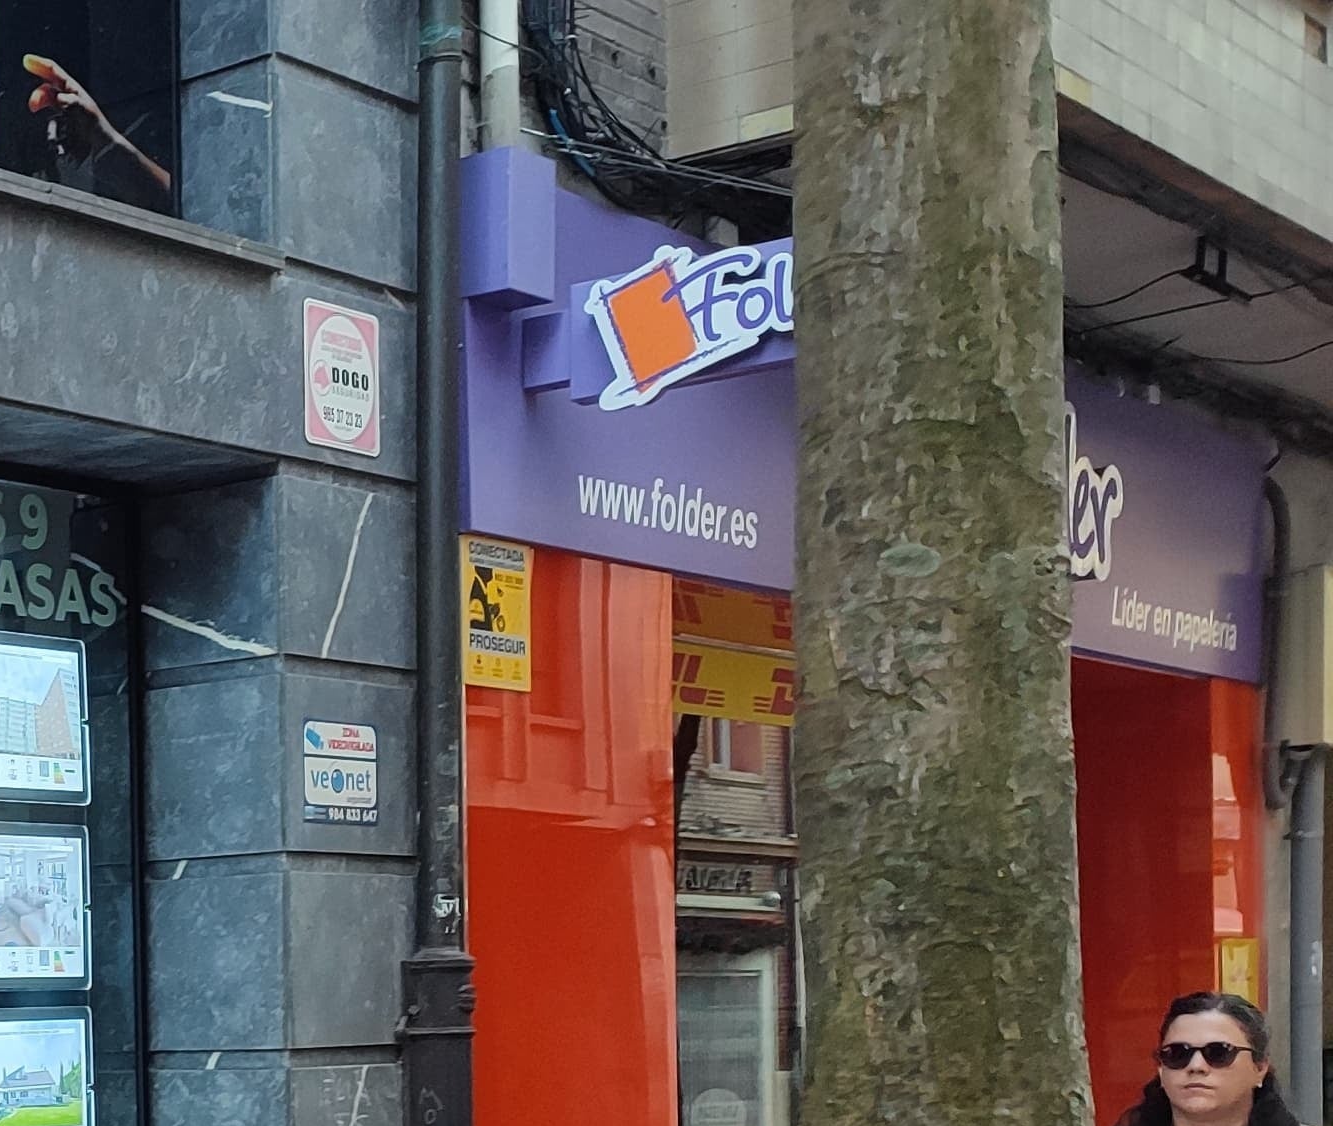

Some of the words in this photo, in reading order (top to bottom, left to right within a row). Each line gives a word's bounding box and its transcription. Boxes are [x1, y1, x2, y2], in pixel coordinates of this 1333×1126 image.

[661, 253, 795, 343] Fol
[332, 366, 370, 391] DOGO
[19, 493, 49, 551] 9
[577, 474, 759, 549] www.folder.es
[469, 632, 526, 656] PROSEGUR
[1111, 585, 1151, 634] Líder
[1153, 604, 1171, 636] en
[1173, 608, 1238, 653] papelería
